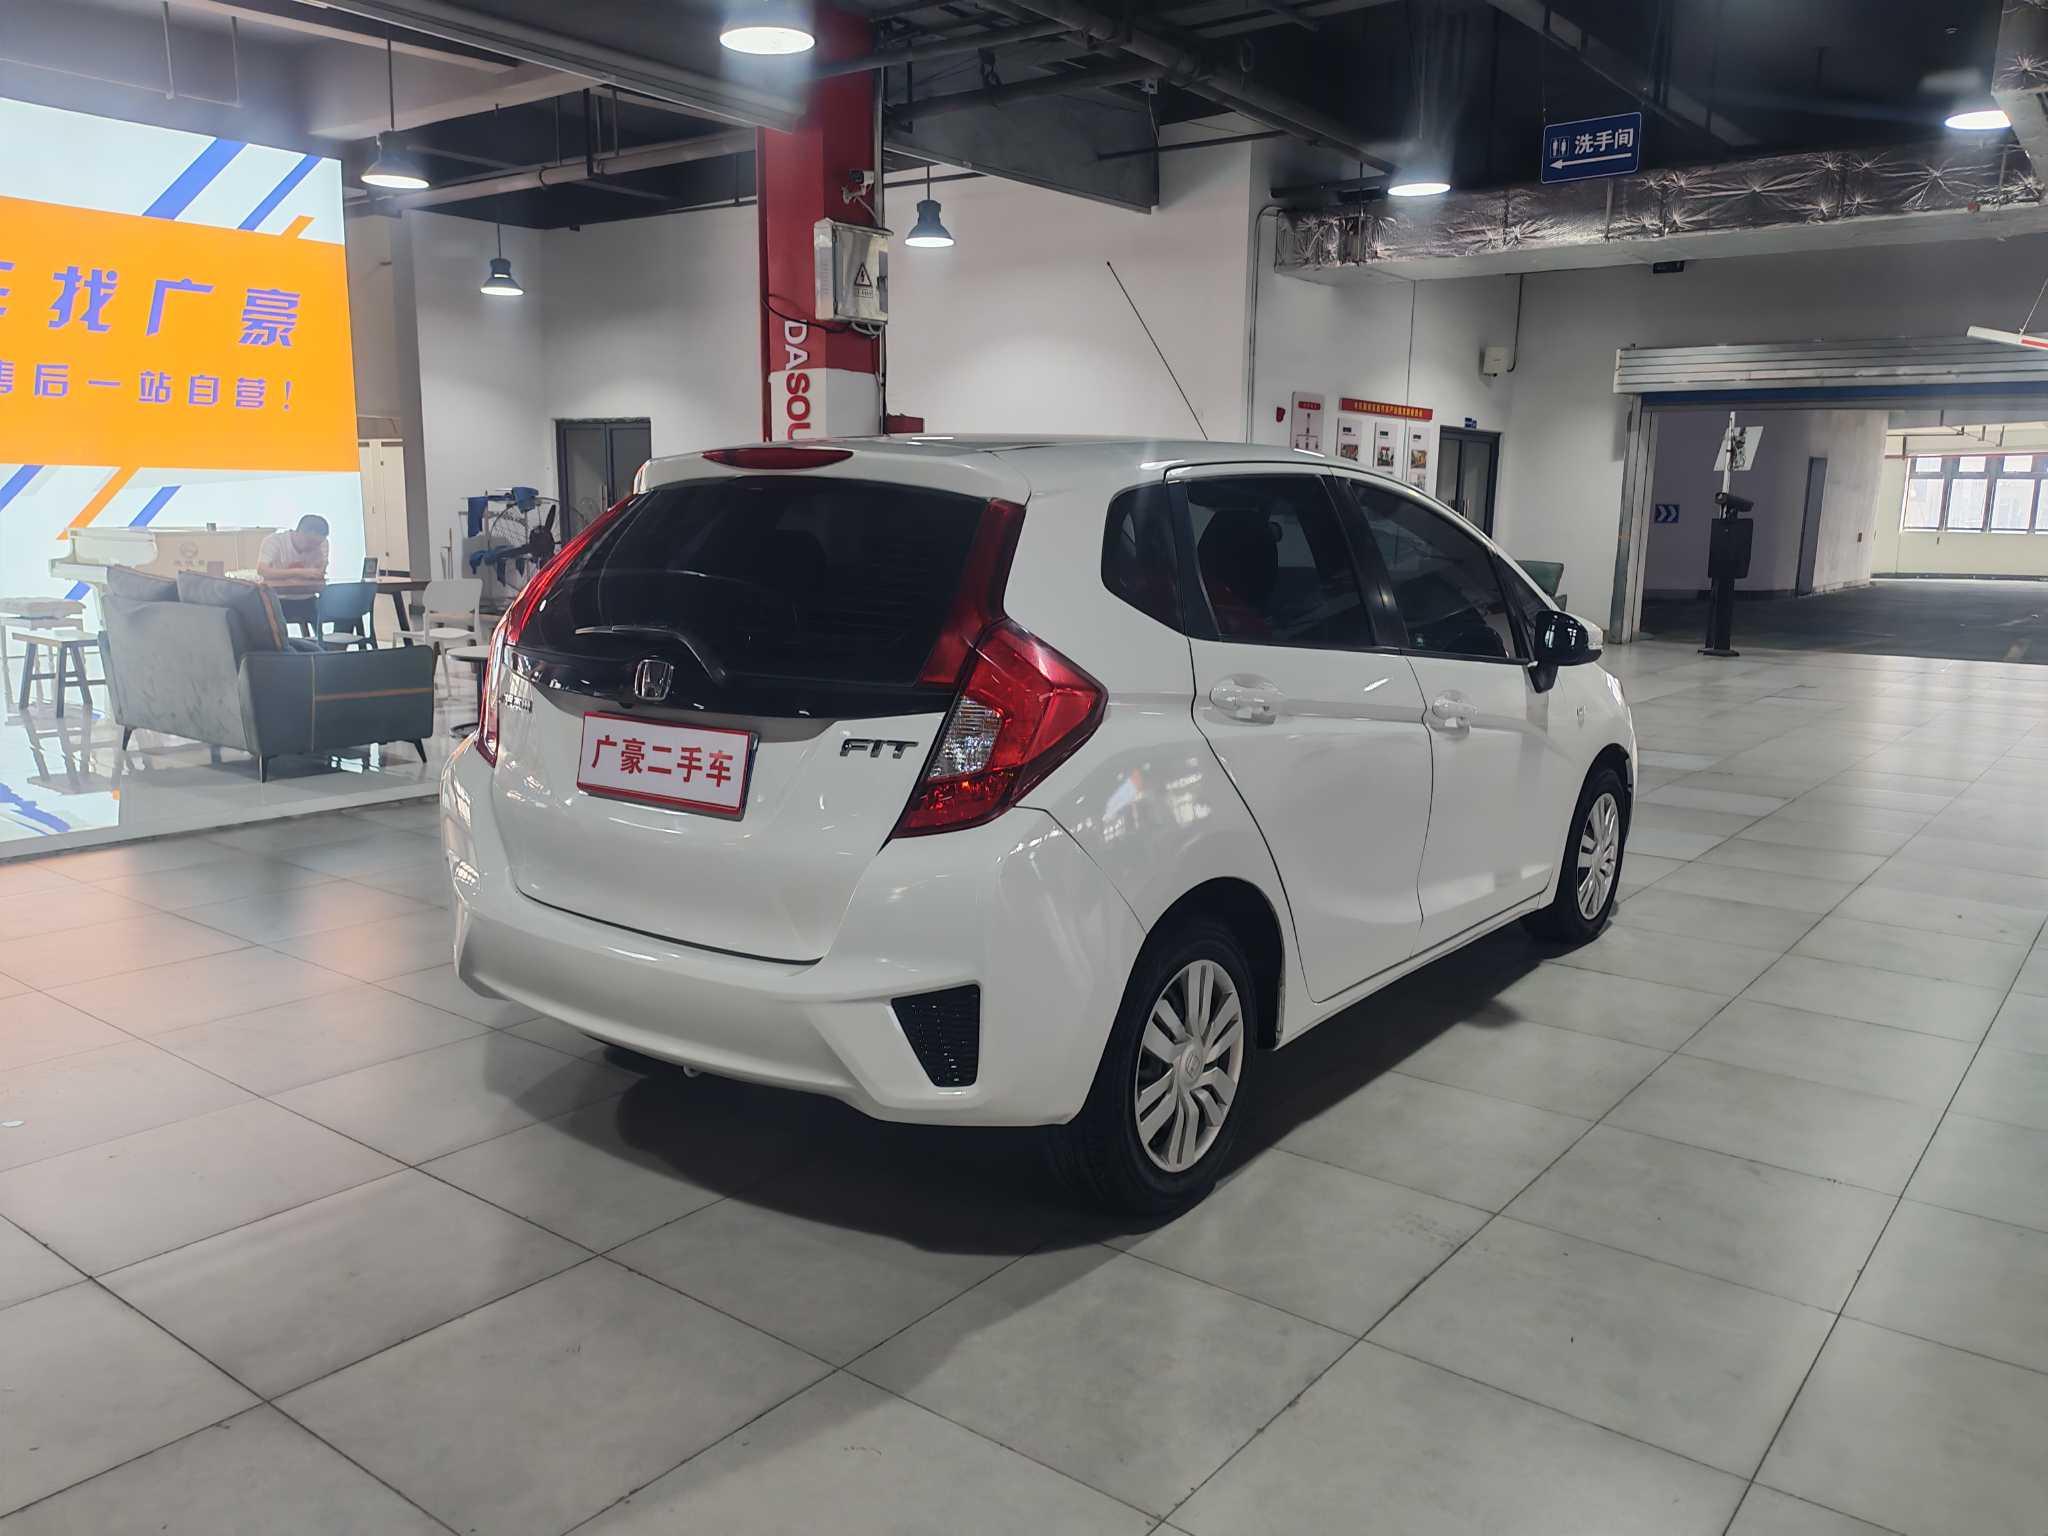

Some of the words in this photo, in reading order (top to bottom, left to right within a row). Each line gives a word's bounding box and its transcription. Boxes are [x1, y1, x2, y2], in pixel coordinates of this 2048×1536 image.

[1574, 127, 1634, 155] 洗手间
[0, 261, 301, 347] 找广豪
[591, 734, 734, 788] 广豪二手车
[840, 738, 919, 759] FIT
